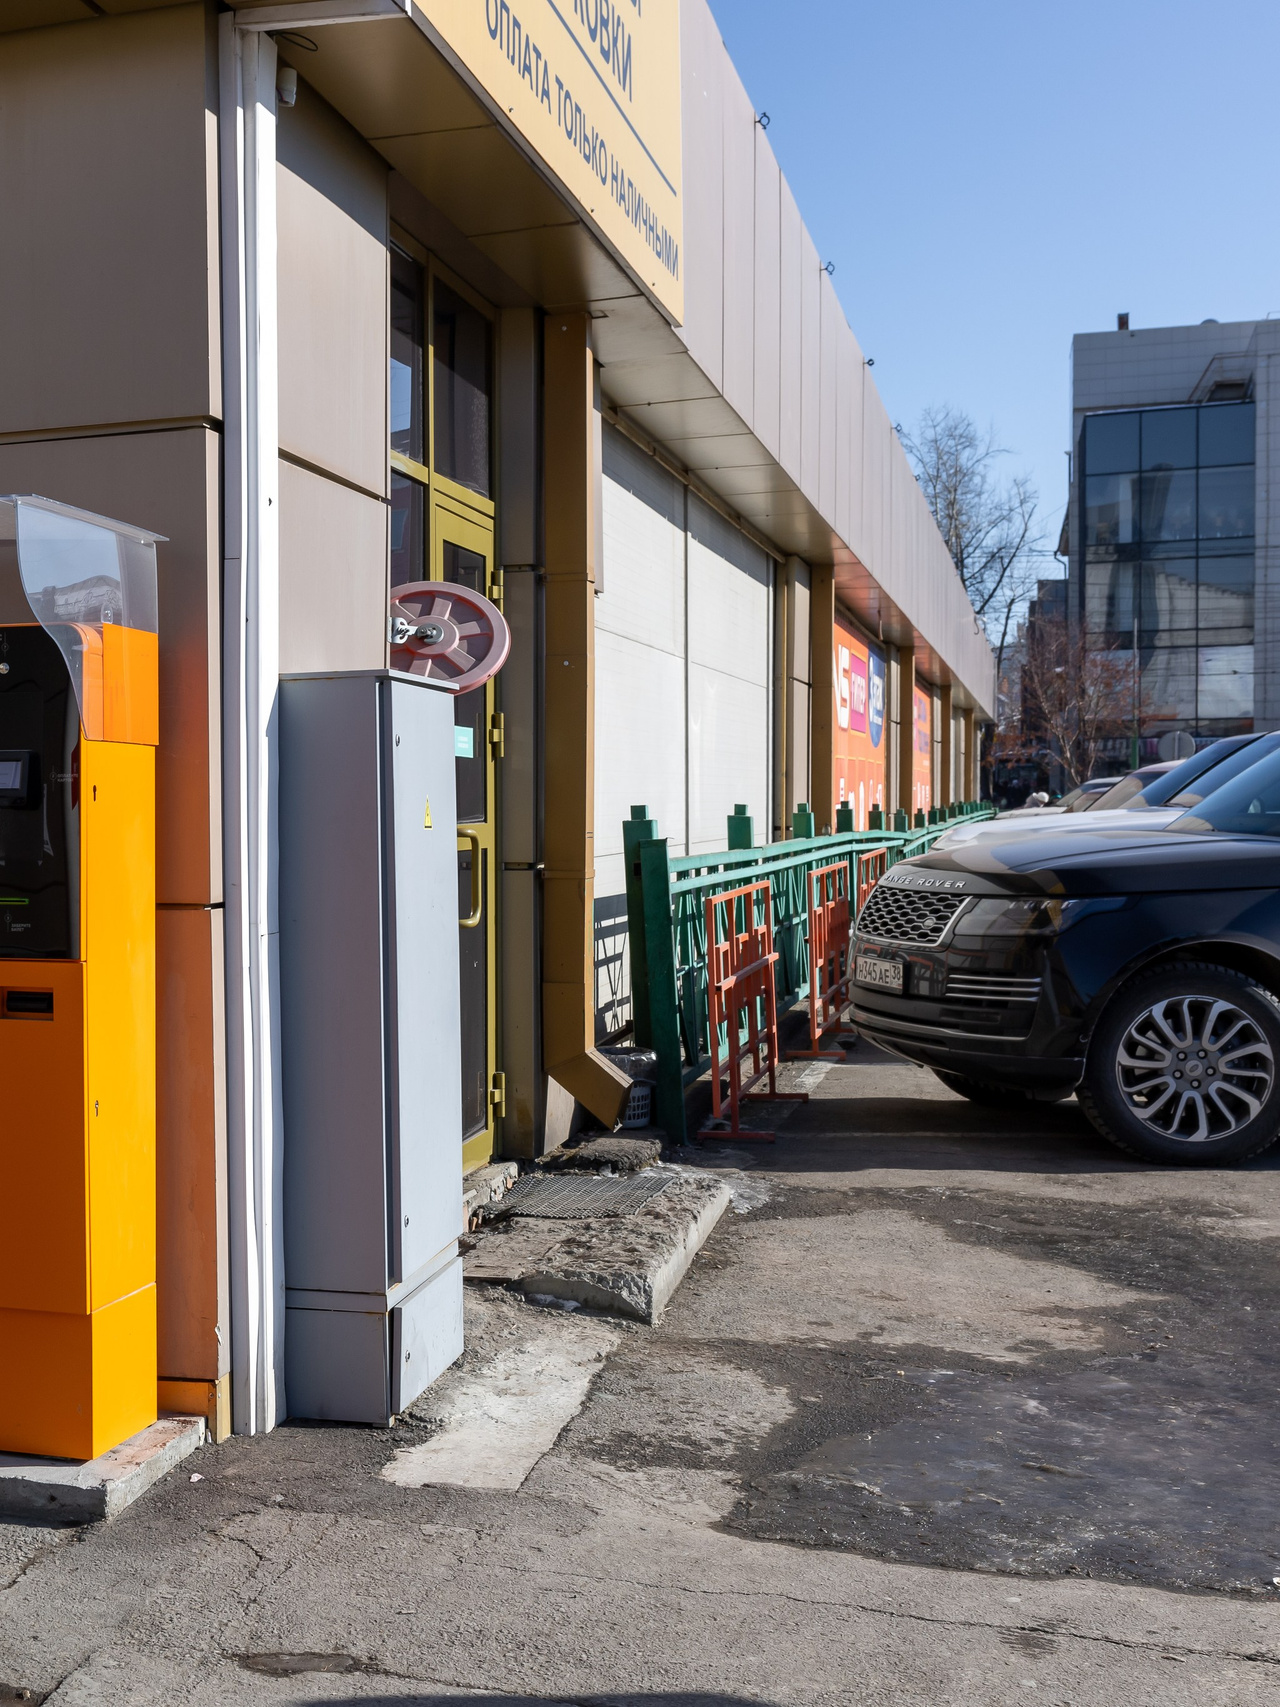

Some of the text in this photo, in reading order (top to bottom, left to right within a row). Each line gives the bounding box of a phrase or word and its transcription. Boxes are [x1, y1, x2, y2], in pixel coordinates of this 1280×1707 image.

[574, 0, 633, 103] ОВКИ
[485, 0, 679, 281] ОПЛАТА ТОЛЬКО НАЛИЧНЫМИ
[916, 878, 966, 889] ROVER
[891, 965, 901, 981] 38
